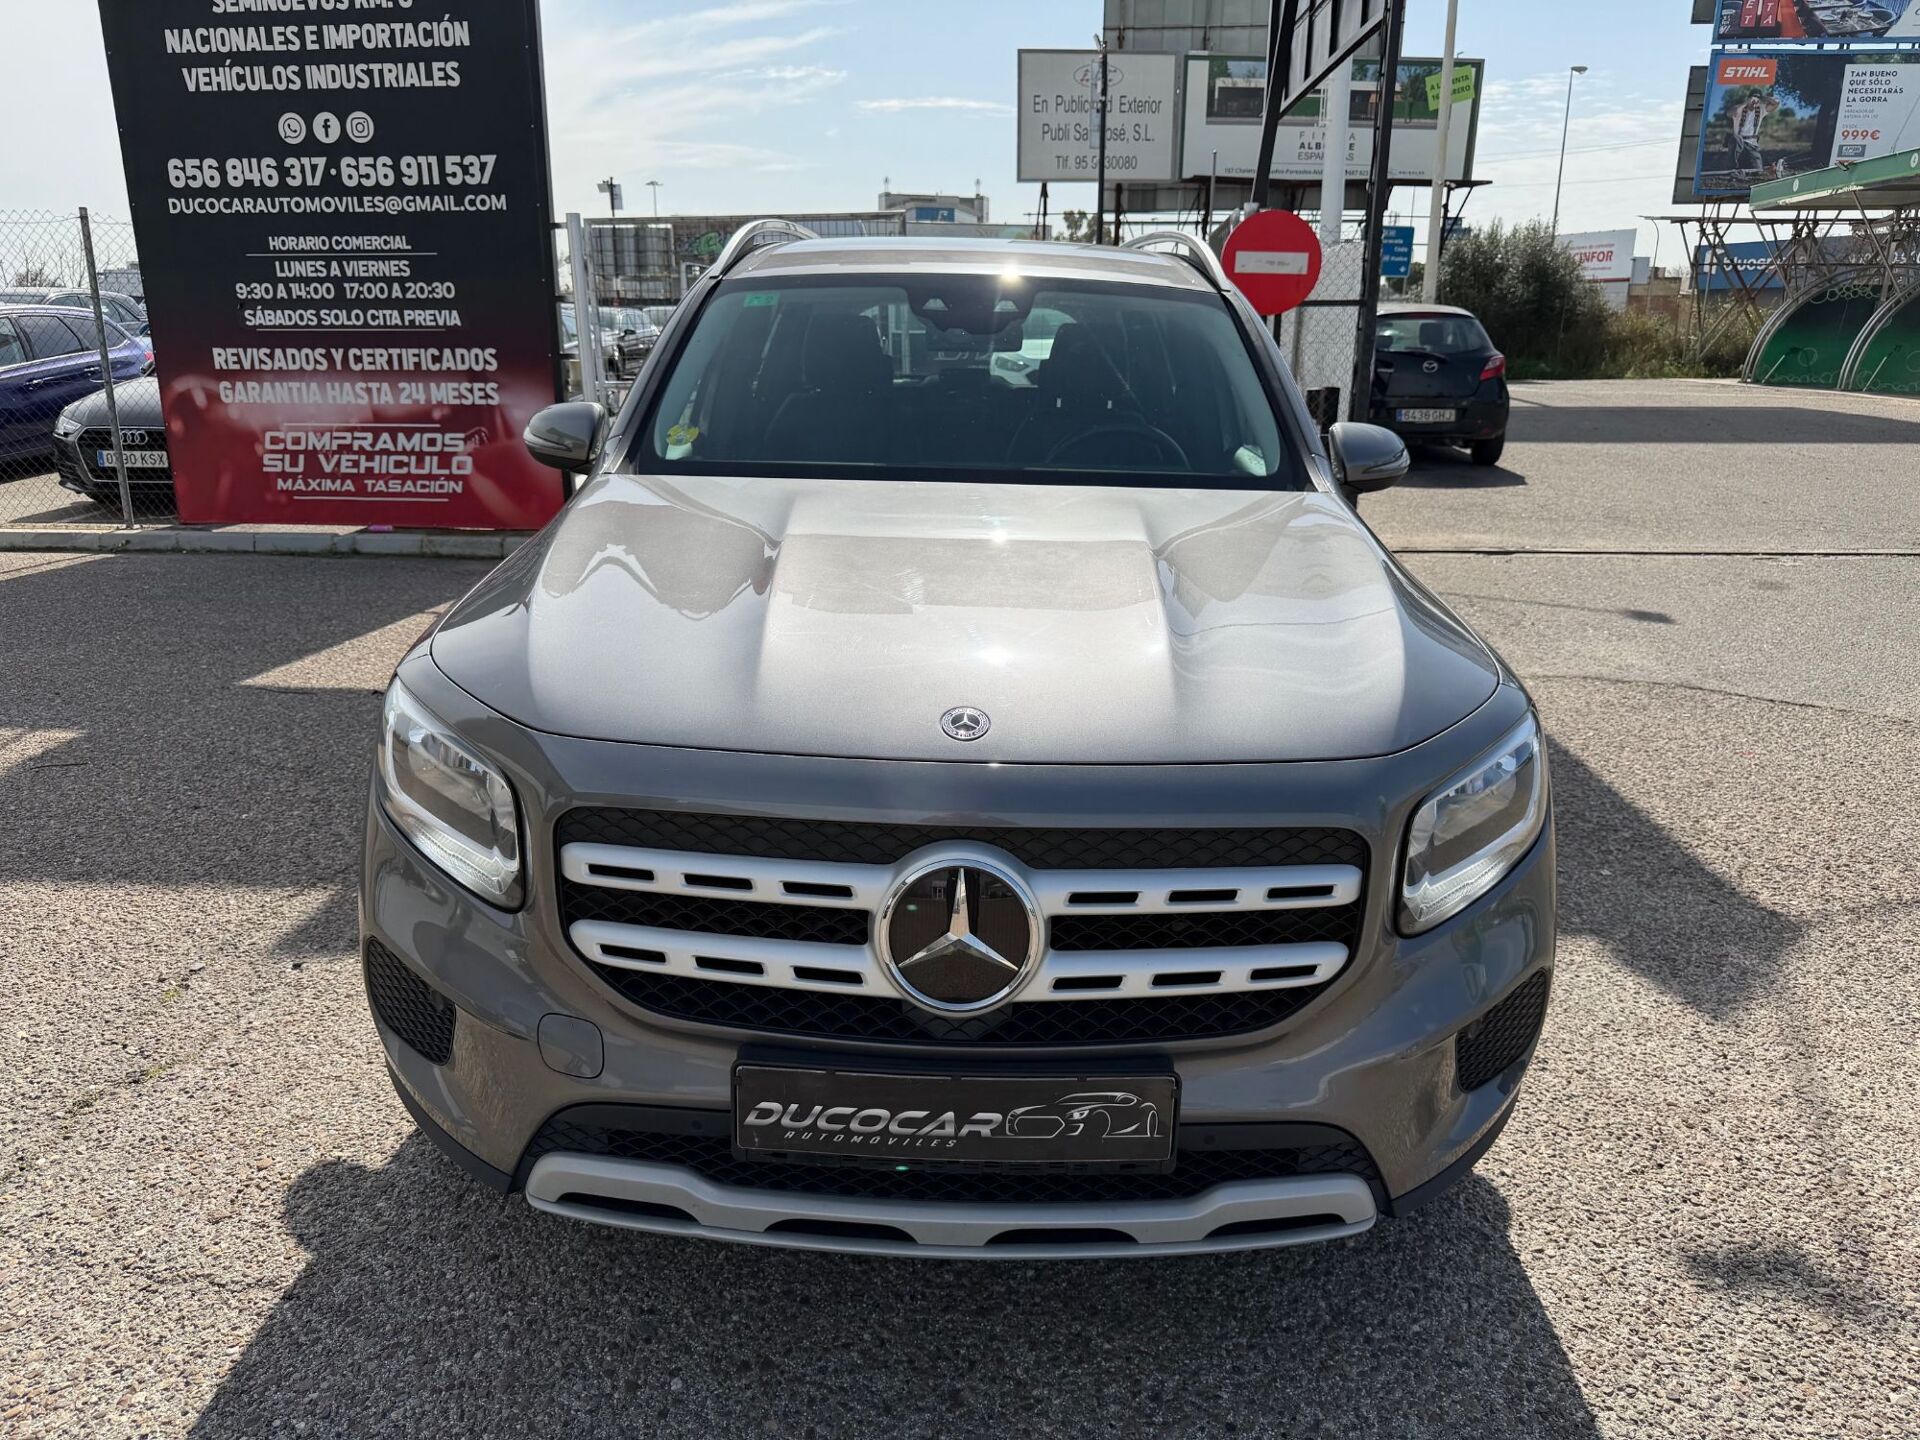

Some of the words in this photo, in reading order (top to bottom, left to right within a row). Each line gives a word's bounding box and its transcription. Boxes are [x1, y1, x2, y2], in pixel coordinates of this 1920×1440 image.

[164, 25, 300, 53] NACIONALES
[305, 25, 323, 50] E
[323, 14, 470, 49] IMPORTACIÓN
[181, 59, 301, 92] VEHÍCULOS
[306, 61, 461, 90] INDUSTRIALES
[1723, 66, 1769, 79] STIHL
[1868, 78, 1891, 86] SÓLO
[1847, 86, 1904, 94] NECESITARÁS
[1033, 95, 1048, 114] En
[1055, 95, 1113, 114] Publicd
[1119, 95, 1162, 114] Exterior
[1042, 123, 1070, 141] Publi
[1074, 123, 1089, 142] Sa
[1106, 124, 1130, 143] osé,
[1133, 123, 1155, 142] S.L.
[1299, 131, 1356, 141] FIA
[1841, 129, 1881, 140] 999€
[167, 157, 220, 188] 656
[226, 156, 279, 187] 846
[401, 155, 439, 185] 911
[445, 154, 498, 185] 537
[1055, 156, 1071, 170] Tlf.
[1074, 156, 1088, 170] 95
[167, 194, 507, 214] DUCOCARAUTOMOVILES@GMAIL.COM
[269, 236, 328, 251] HORARIO
[331, 235, 411, 251] COMERCIAL
[275, 261, 326, 278] LUNES
[330, 261, 343, 277] A
[343, 260, 410, 277] VIERNES
[235, 283, 273, 300] 9:30
[275, 283, 289, 299] A
[289, 282, 334, 299] 14:00
[344, 282, 388, 299] 17:00
[391, 282, 403, 299] A
[405, 282, 455, 299] 20:30
[244, 305, 318, 326] SÁBADOS
[320, 310, 363, 326] SOLO
[366, 309, 402, 326] CITA
[404, 309, 462, 327] PREVIA
[212, 348, 328, 371] REVISADOS
[330, 348, 344, 370] Y
[347, 347, 498, 371] CERTIFICADOS
[218, 381, 322, 405] GARANTIA
[327, 382, 394, 405] HASTA
[398, 382, 426, 405] 24
[430, 382, 500, 406] MESES
[263, 432, 466, 453] COMPRAMOS
[106, 452, 137, 465] 090
[141, 452, 165, 465] KSX
[262, 454, 305, 473] SU
[317, 454, 473, 476] VEHICULO
[276, 476, 355, 493] MÁXIMA
[364, 477, 463, 494] TASACIÓN
[743, 1101, 1003, 1137] DUCOCAR
